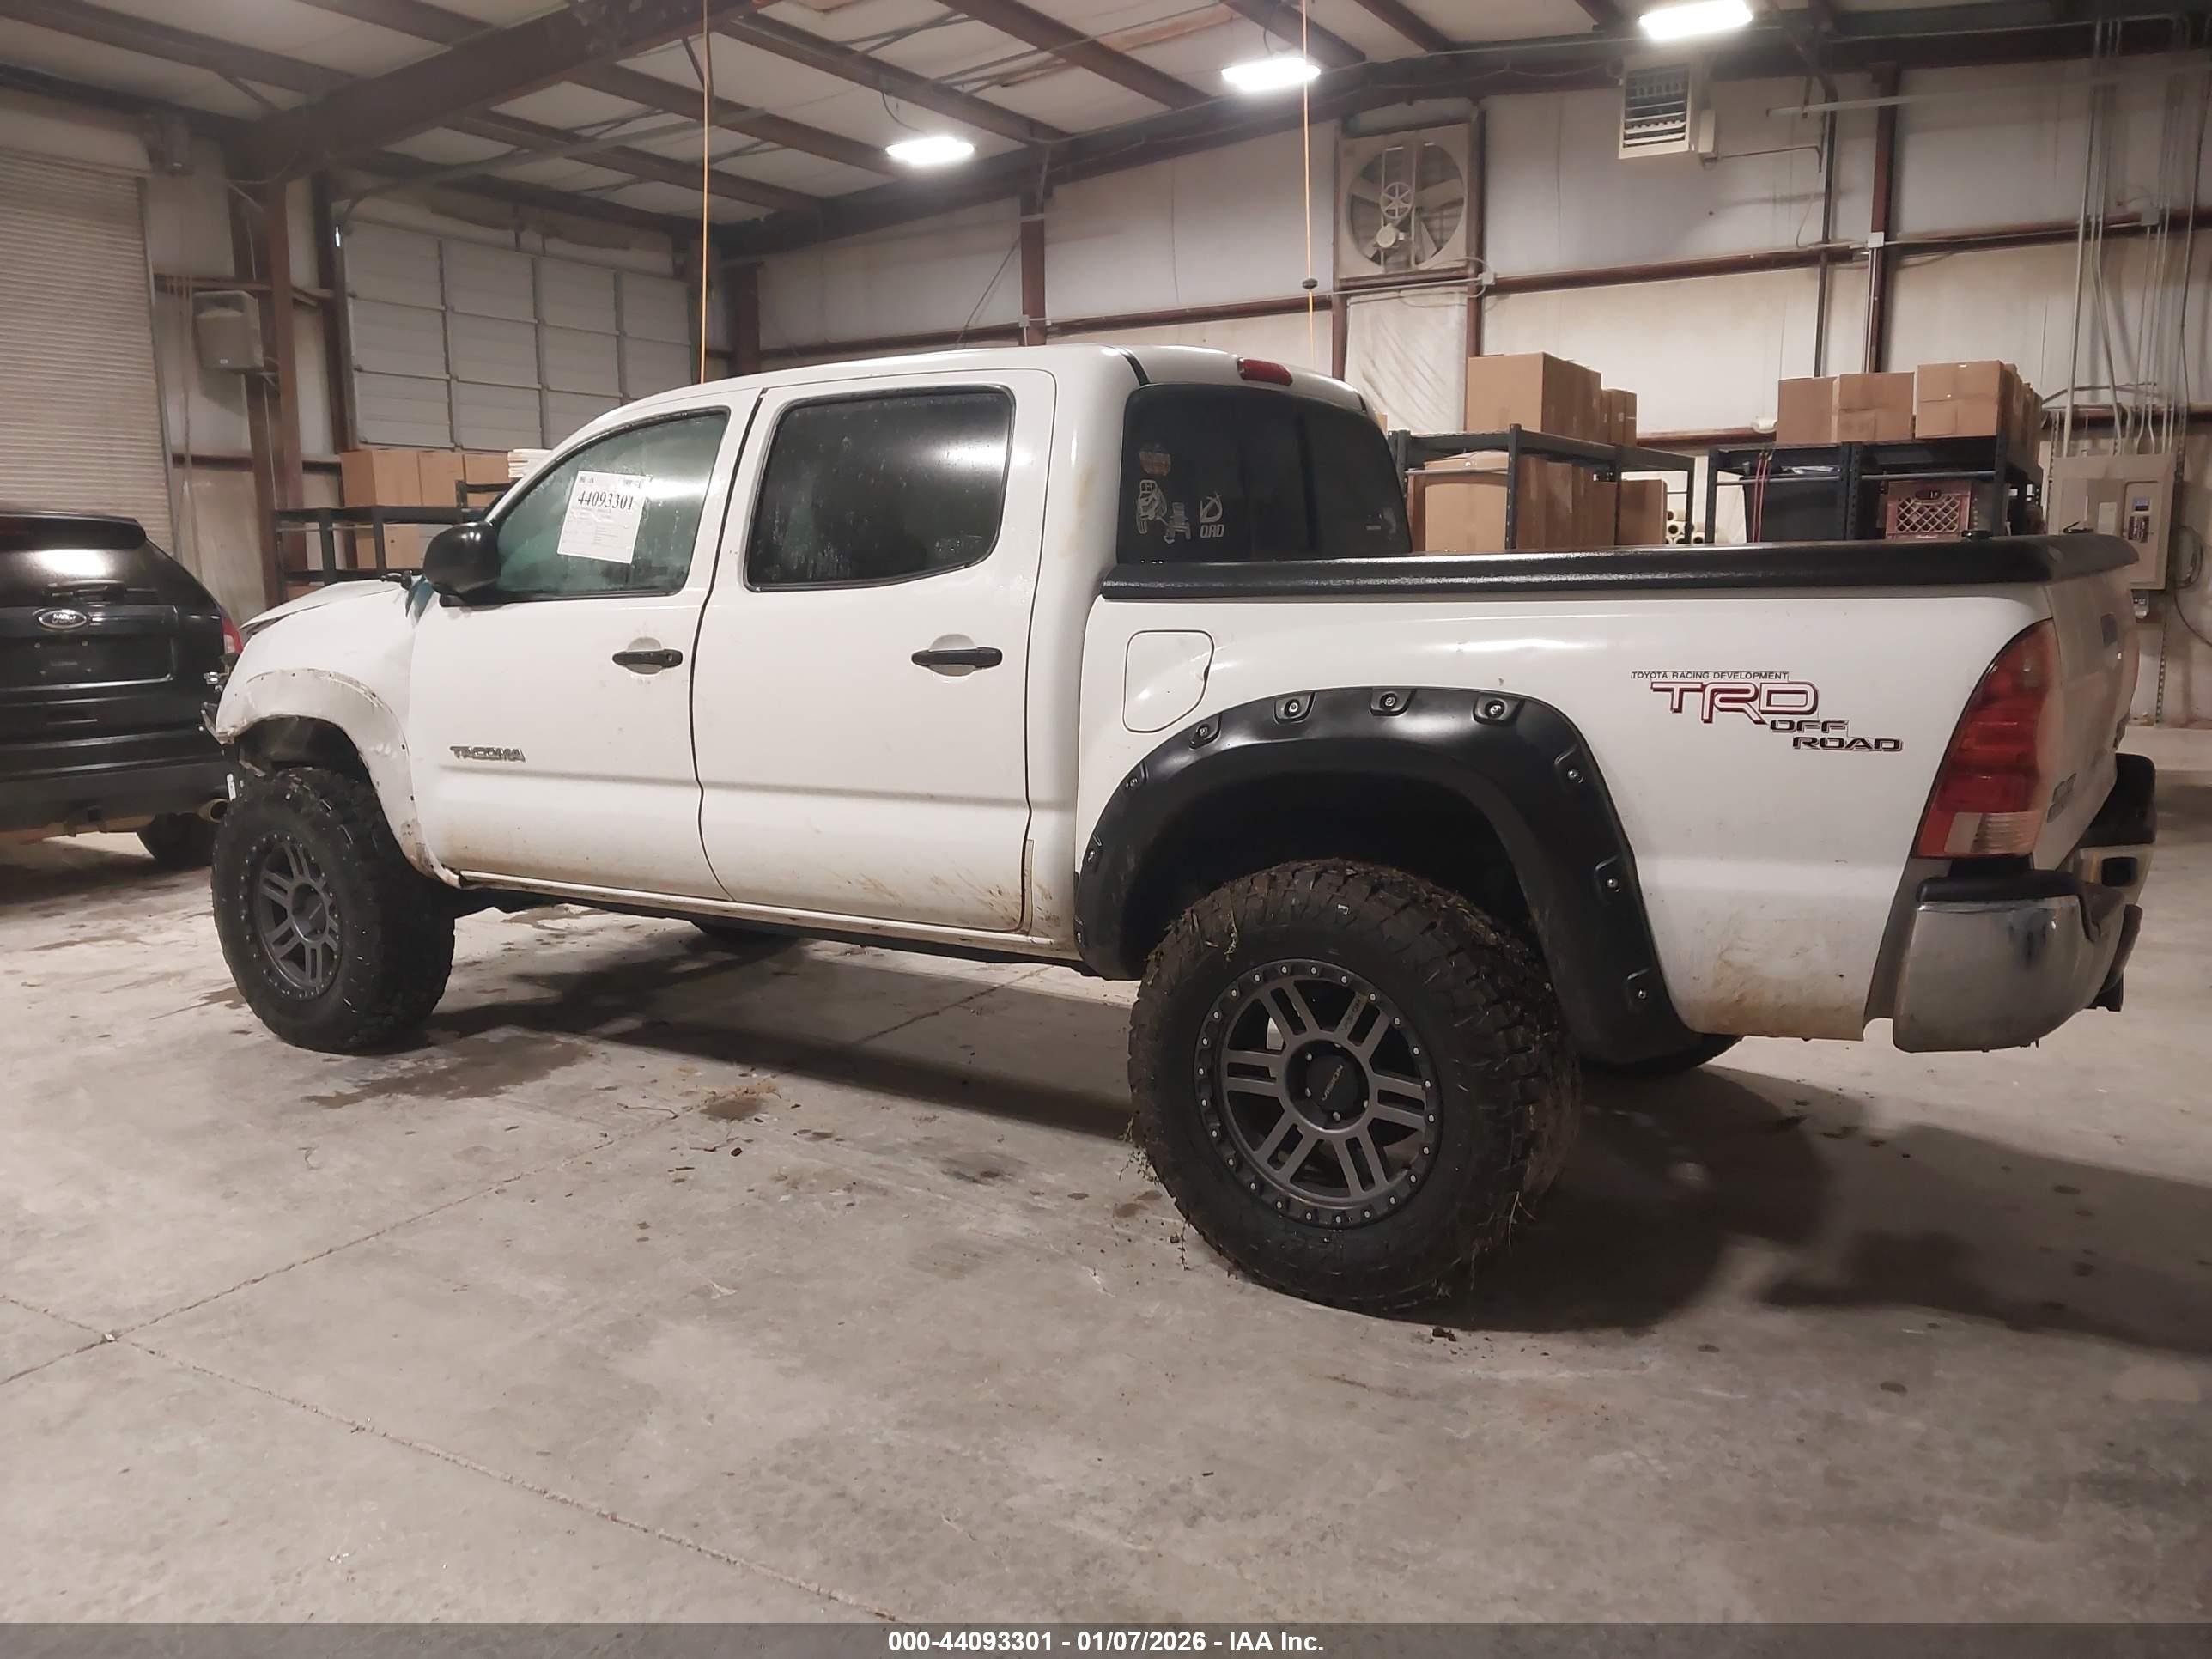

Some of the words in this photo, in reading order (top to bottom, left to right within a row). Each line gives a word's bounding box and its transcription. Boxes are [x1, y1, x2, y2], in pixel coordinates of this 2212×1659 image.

[577, 490, 634, 511] 44093301
[1631, 671, 1668, 679] TOYOTA
[1672, 671, 1710, 679] RACING
[1713, 671, 1789, 680] DEVELOPMENT
[1650, 681, 1820, 725] TRD
[1769, 719, 1849, 733] OFF
[1792, 736, 1904, 752] ROAD
[449, 745, 526, 763] TACOMA
